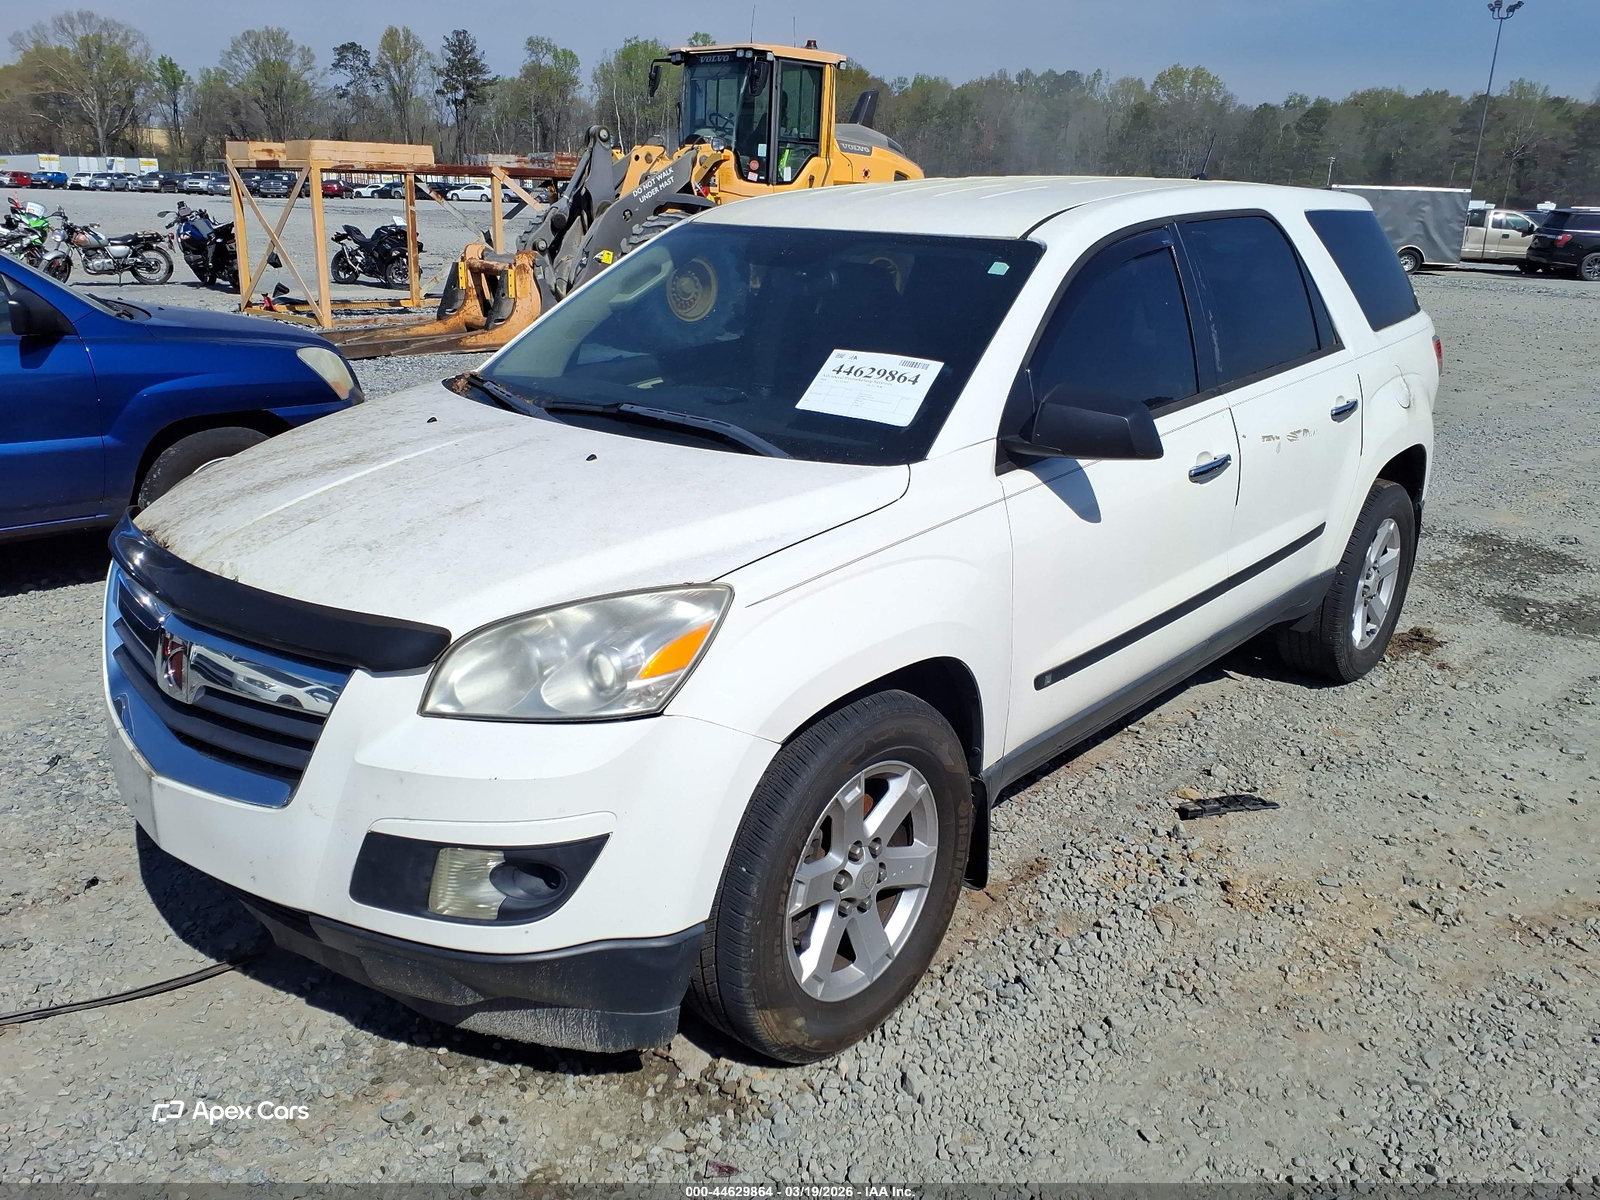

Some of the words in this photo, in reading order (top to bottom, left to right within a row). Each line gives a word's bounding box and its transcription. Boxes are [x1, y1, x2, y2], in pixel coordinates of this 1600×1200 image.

[700, 54, 730, 63] VOLVO
[840, 142, 870, 153] VOLVO
[632, 189, 642, 198] DO
[642, 179, 656, 192] NOT
[656, 167, 674, 181] WALK
[639, 188, 660, 203] UNDER
[658, 176, 674, 191] MAST
[832, 363, 921, 386] 44629864
